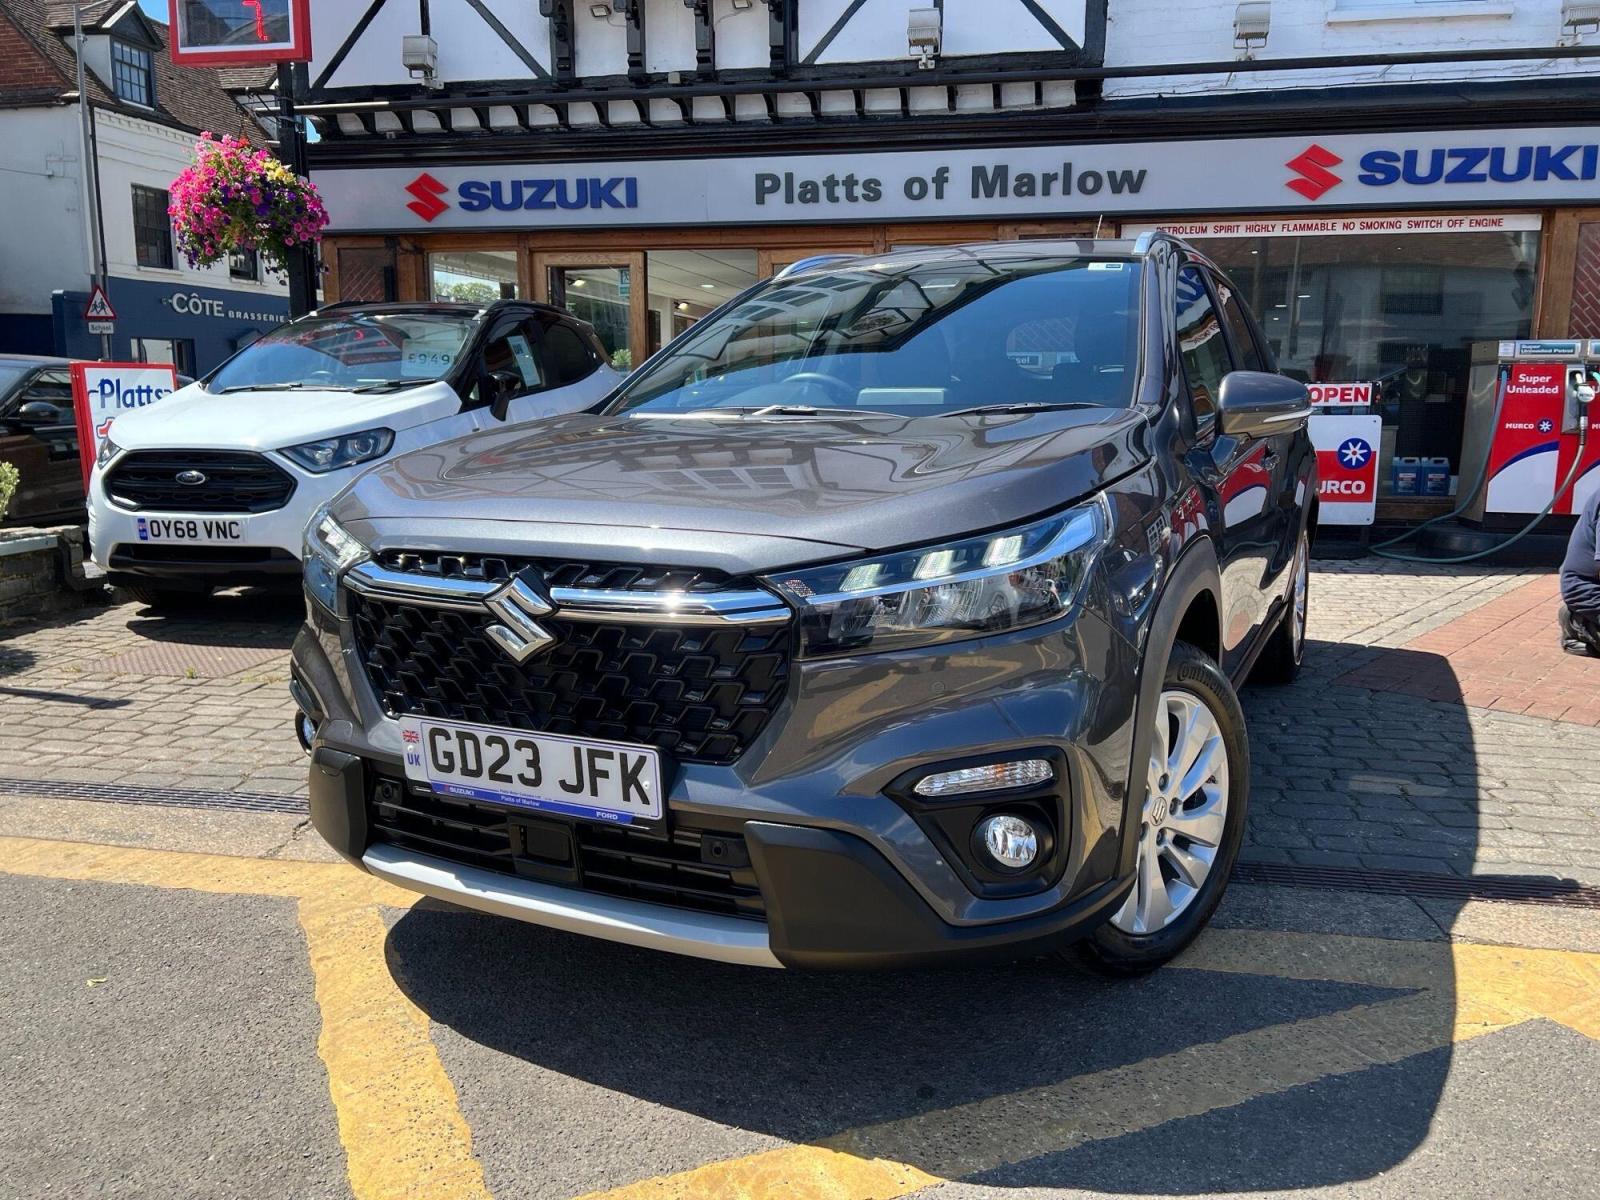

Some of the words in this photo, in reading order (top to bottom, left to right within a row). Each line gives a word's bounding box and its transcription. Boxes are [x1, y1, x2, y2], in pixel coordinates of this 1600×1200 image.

[1358, 144, 1599, 187] SUZUKI
[754, 171, 883, 205] Platts
[903, 165, 949, 201] of
[971, 162, 1147, 199] Marlow
[458, 176, 638, 212] SUZUKI
[1213, 224, 1241, 234] SPIRIT
[1245, 223, 1276, 233] HIGHLY
[1281, 221, 1338, 233] FLAMMABLE
[1342, 221, 1356, 231] NO
[1359, 220, 1403, 231] SMOKING
[1407, 218, 1443, 230] SWITCH
[1447, 218, 1465, 229] OFF
[1469, 217, 1505, 228] ENGINE
[171, 292, 225, 317] CÔTE
[227, 309, 285, 323] BRASSERIE
[1518, 373, 1552, 384] Super
[98, 377, 164, 408] Platts
[1309, 386, 1370, 404] OPEN
[1506, 385, 1559, 394] Unleaded
[1505, 422, 1535, 430] MURCO
[1319, 480, 1366, 495] URCO
[149, 520, 198, 539] OY68
[203, 521, 240, 539] VNC
[407, 753, 421, 766] UK
[428, 727, 543, 788] GD23
[558, 746, 651, 806] JFK
[449, 786, 475, 796] SUZUKI
[596, 811, 618, 820] FORD
